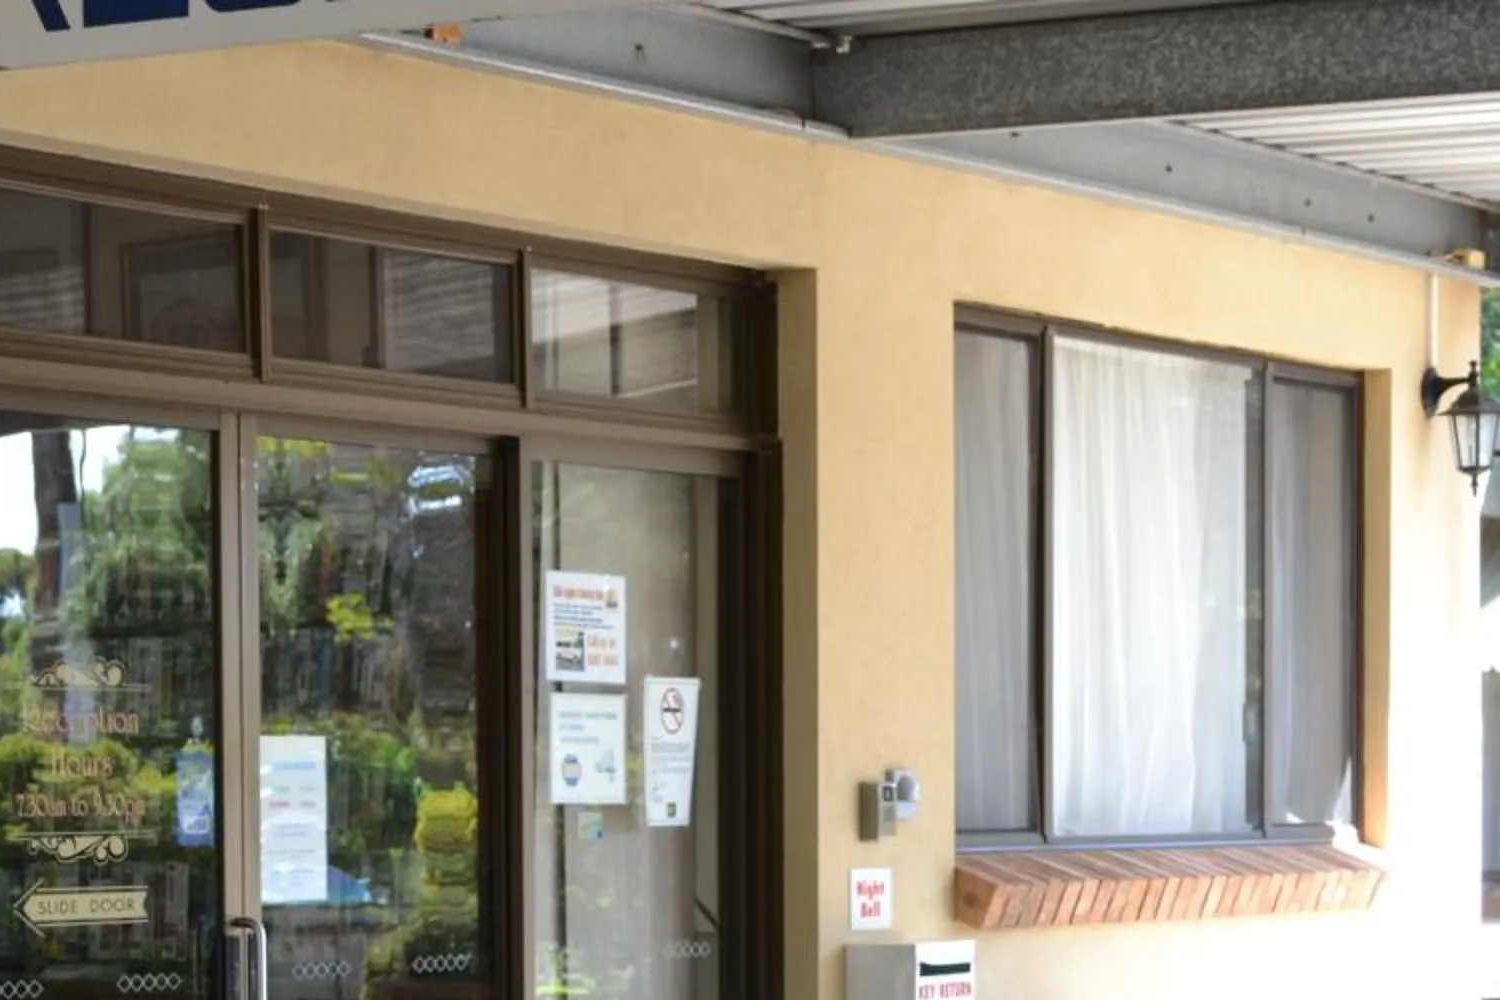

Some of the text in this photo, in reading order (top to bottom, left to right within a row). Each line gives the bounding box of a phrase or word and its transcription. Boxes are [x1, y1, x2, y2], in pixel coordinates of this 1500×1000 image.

[856, 879, 885, 900] Night
[37, 897, 136, 916] SLIDE DOOR
[860, 900, 881, 918] Bell
[918, 981, 972, 1000] KEY RETURN
